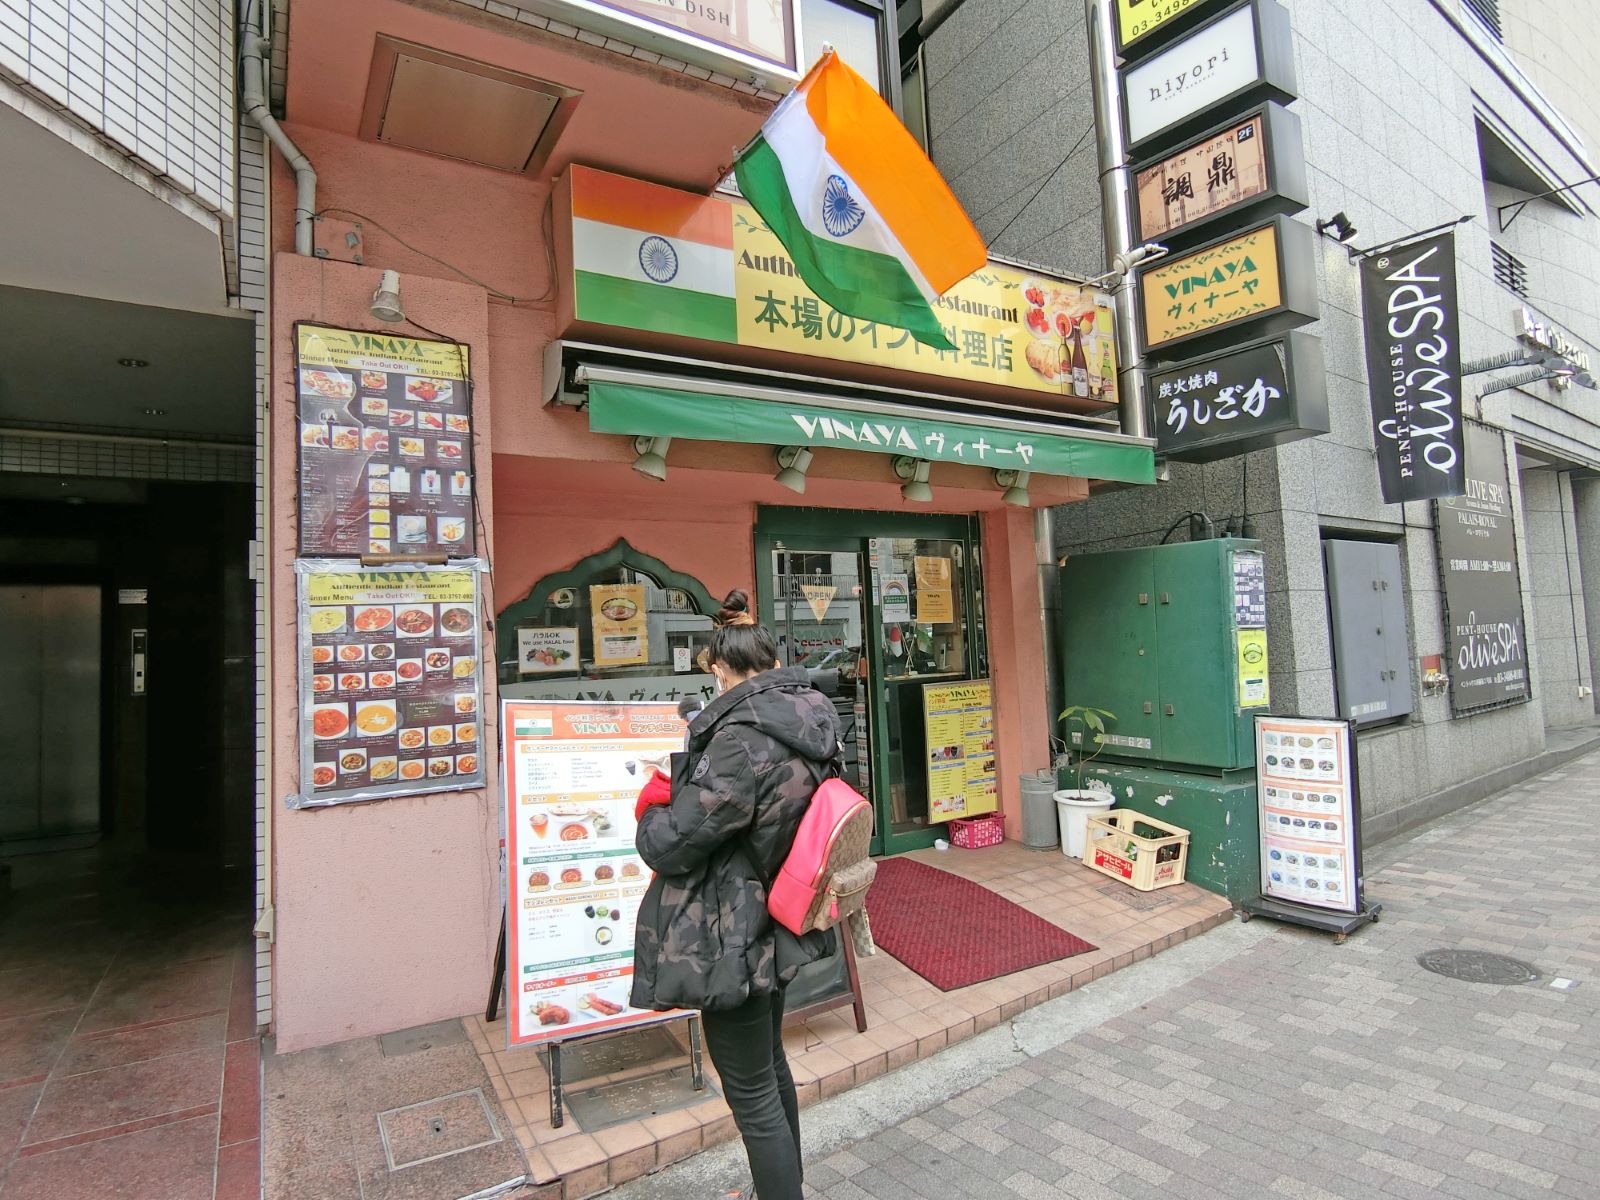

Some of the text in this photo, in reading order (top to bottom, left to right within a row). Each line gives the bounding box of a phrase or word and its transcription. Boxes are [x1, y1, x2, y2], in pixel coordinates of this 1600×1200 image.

[685, 0, 729, 26] DISH
[1149, 48, 1230, 101] hiyori
[1238, 126, 1253, 140] 2F
[1163, 255, 1258, 300] VINAYA
[934, 293, 1020, 324] estaurant
[1167, 277, 1259, 320] ヴィナーヤ
[350, 334, 424, 357] VINAYA
[299, 353, 348, 365] Dinner Menu
[361, 359, 378, 367] Take
[1158, 370, 1219, 399] 炭火焼肉
[1166, 378, 1281, 435] うしざか
[1389, 343, 1413, 478] PENT-HOUSE
[791, 414, 1034, 465] VINAYA ヴィナーヤ
[1465, 478, 1505, 504] LIVE SPA
[332, 593, 354, 601] Menu
[367, 592, 385, 600] Take
[385, 592, 398, 600] Out
[808, 591, 832, 601] OPEN
[1456, 623, 1498, 636] PENT-HOUSE
[573, 723, 620, 734] VINAYA
[630, 722, 688, 734] ランチメニュー
[1096, 850, 1132, 871] アサヒビール
